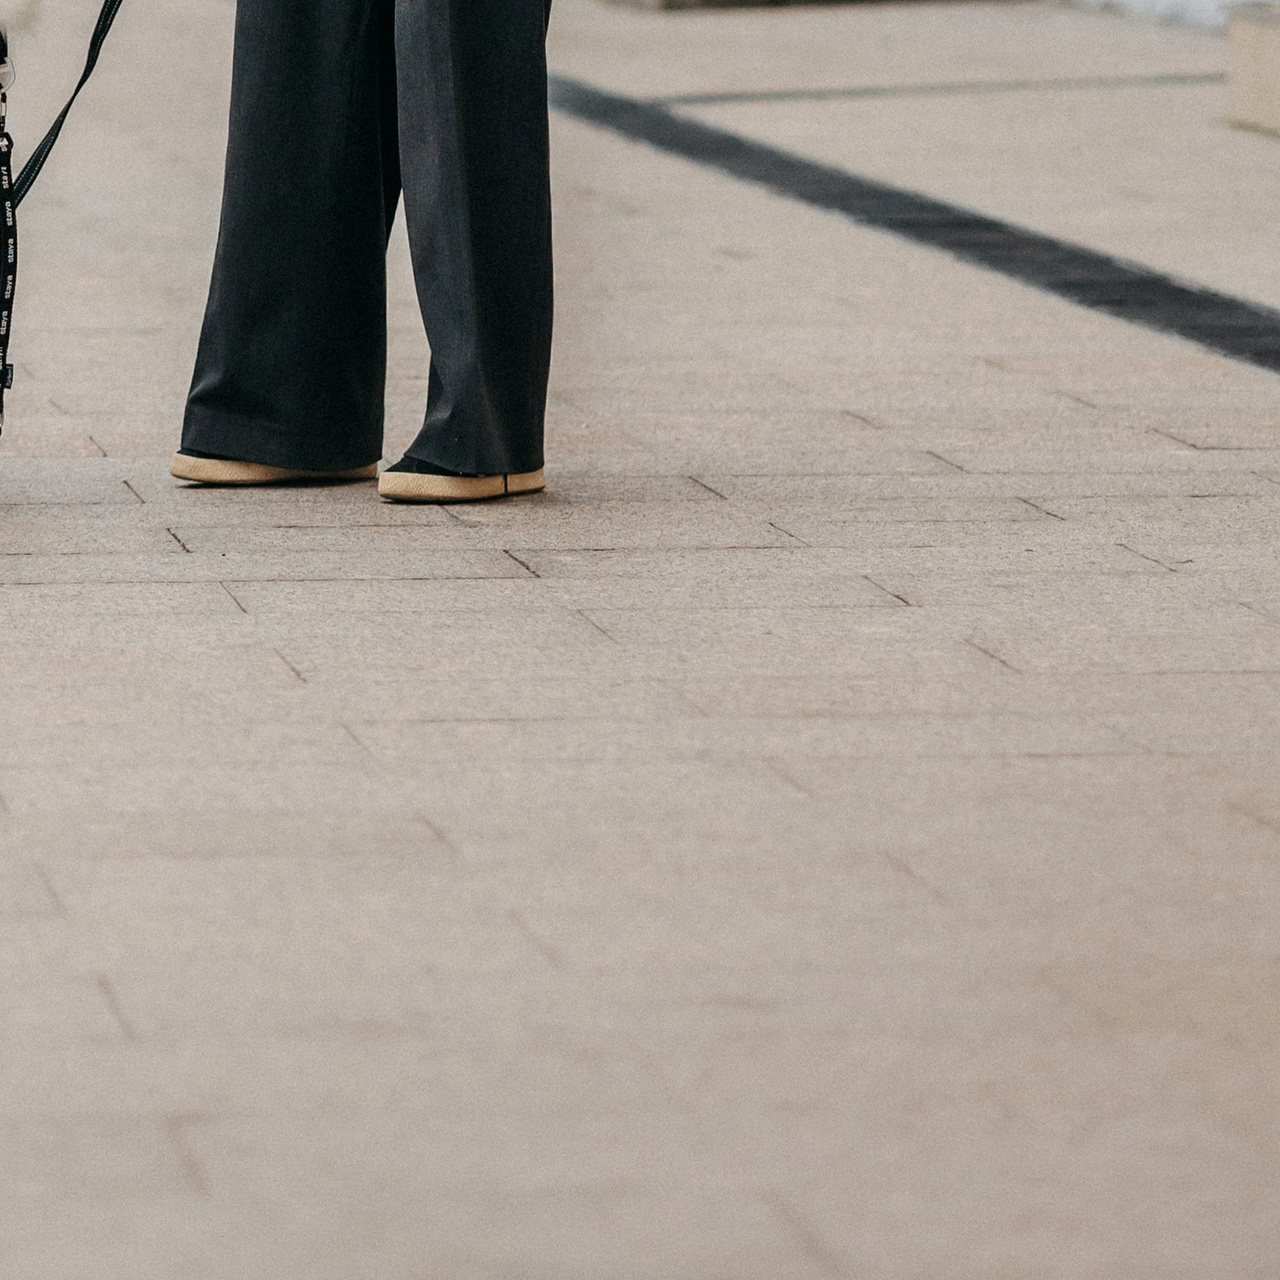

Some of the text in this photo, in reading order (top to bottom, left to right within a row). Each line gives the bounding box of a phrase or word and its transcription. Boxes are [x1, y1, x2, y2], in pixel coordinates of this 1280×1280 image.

[5, 201, 13, 227] staya
[7, 238, 15, 263] staya
[4, 274, 14, 299] staya
[0, 310, 9, 335] staya
